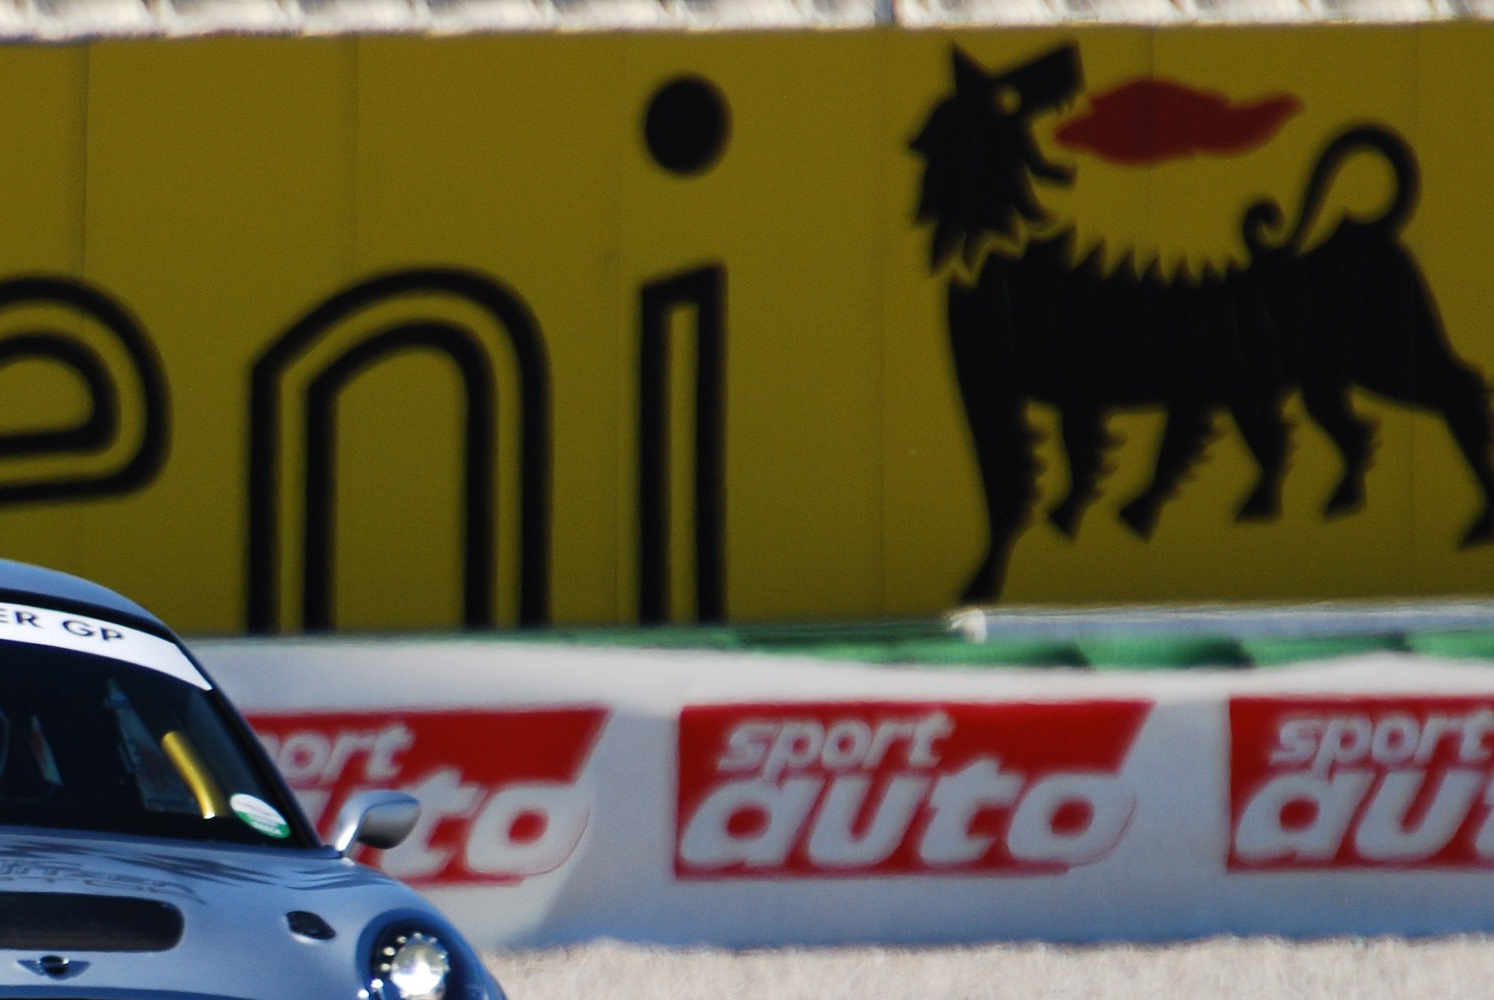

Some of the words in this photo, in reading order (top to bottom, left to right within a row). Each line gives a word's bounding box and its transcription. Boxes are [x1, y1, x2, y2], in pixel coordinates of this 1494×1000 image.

[61, 619, 126, 642] GP
[717, 709, 956, 786] sport
[679, 755, 1137, 867] auto
[1234, 767, 1494, 863] au
